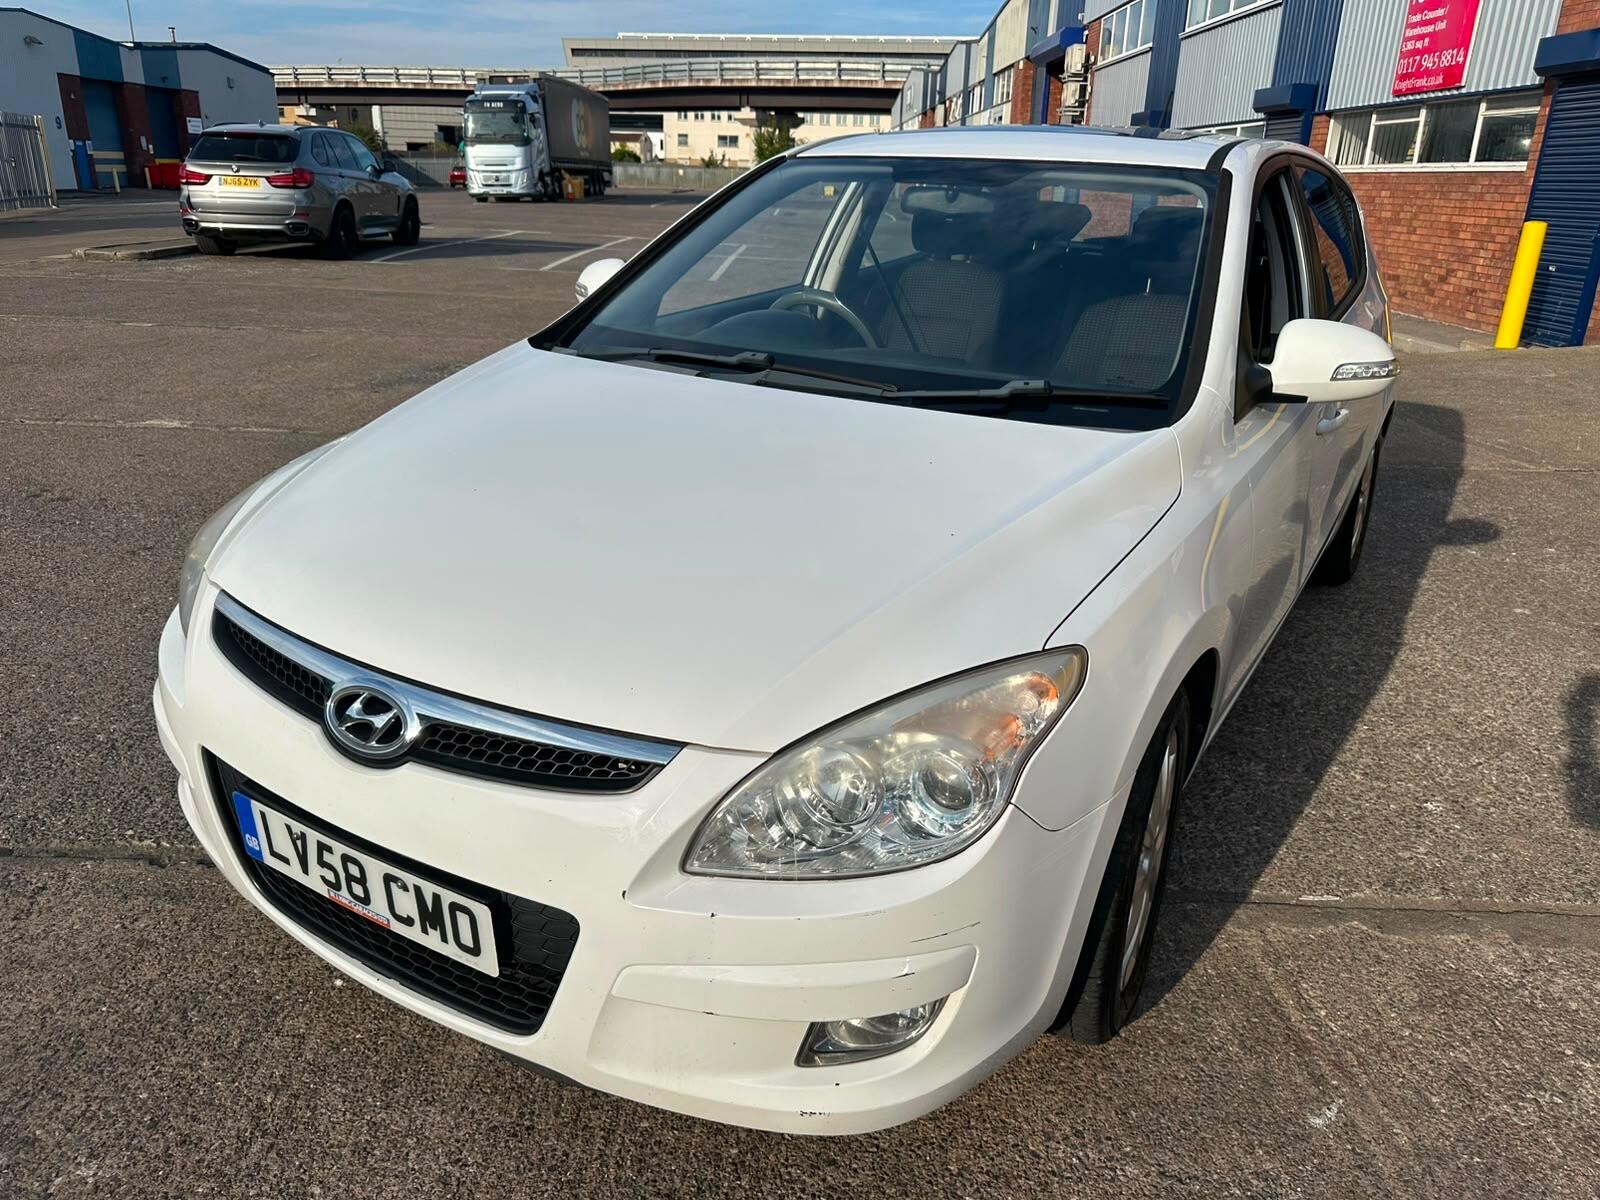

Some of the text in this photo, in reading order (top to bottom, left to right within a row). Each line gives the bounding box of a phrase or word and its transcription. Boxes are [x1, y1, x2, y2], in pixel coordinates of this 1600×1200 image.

[1422, 8, 1446, 20] Counter
[1404, 19, 1448, 37] Warehouse Unit
[1415, 39, 1424, 50] sq
[1424, 37, 1430, 47] ft
[1398, 47, 1464, 74] 0117 945 8814
[56, 115, 62, 129] 9
[223, 177, 258, 186] NJ65 ZYK
[245, 833, 260, 851] GB
[259, 808, 372, 908] LV58
